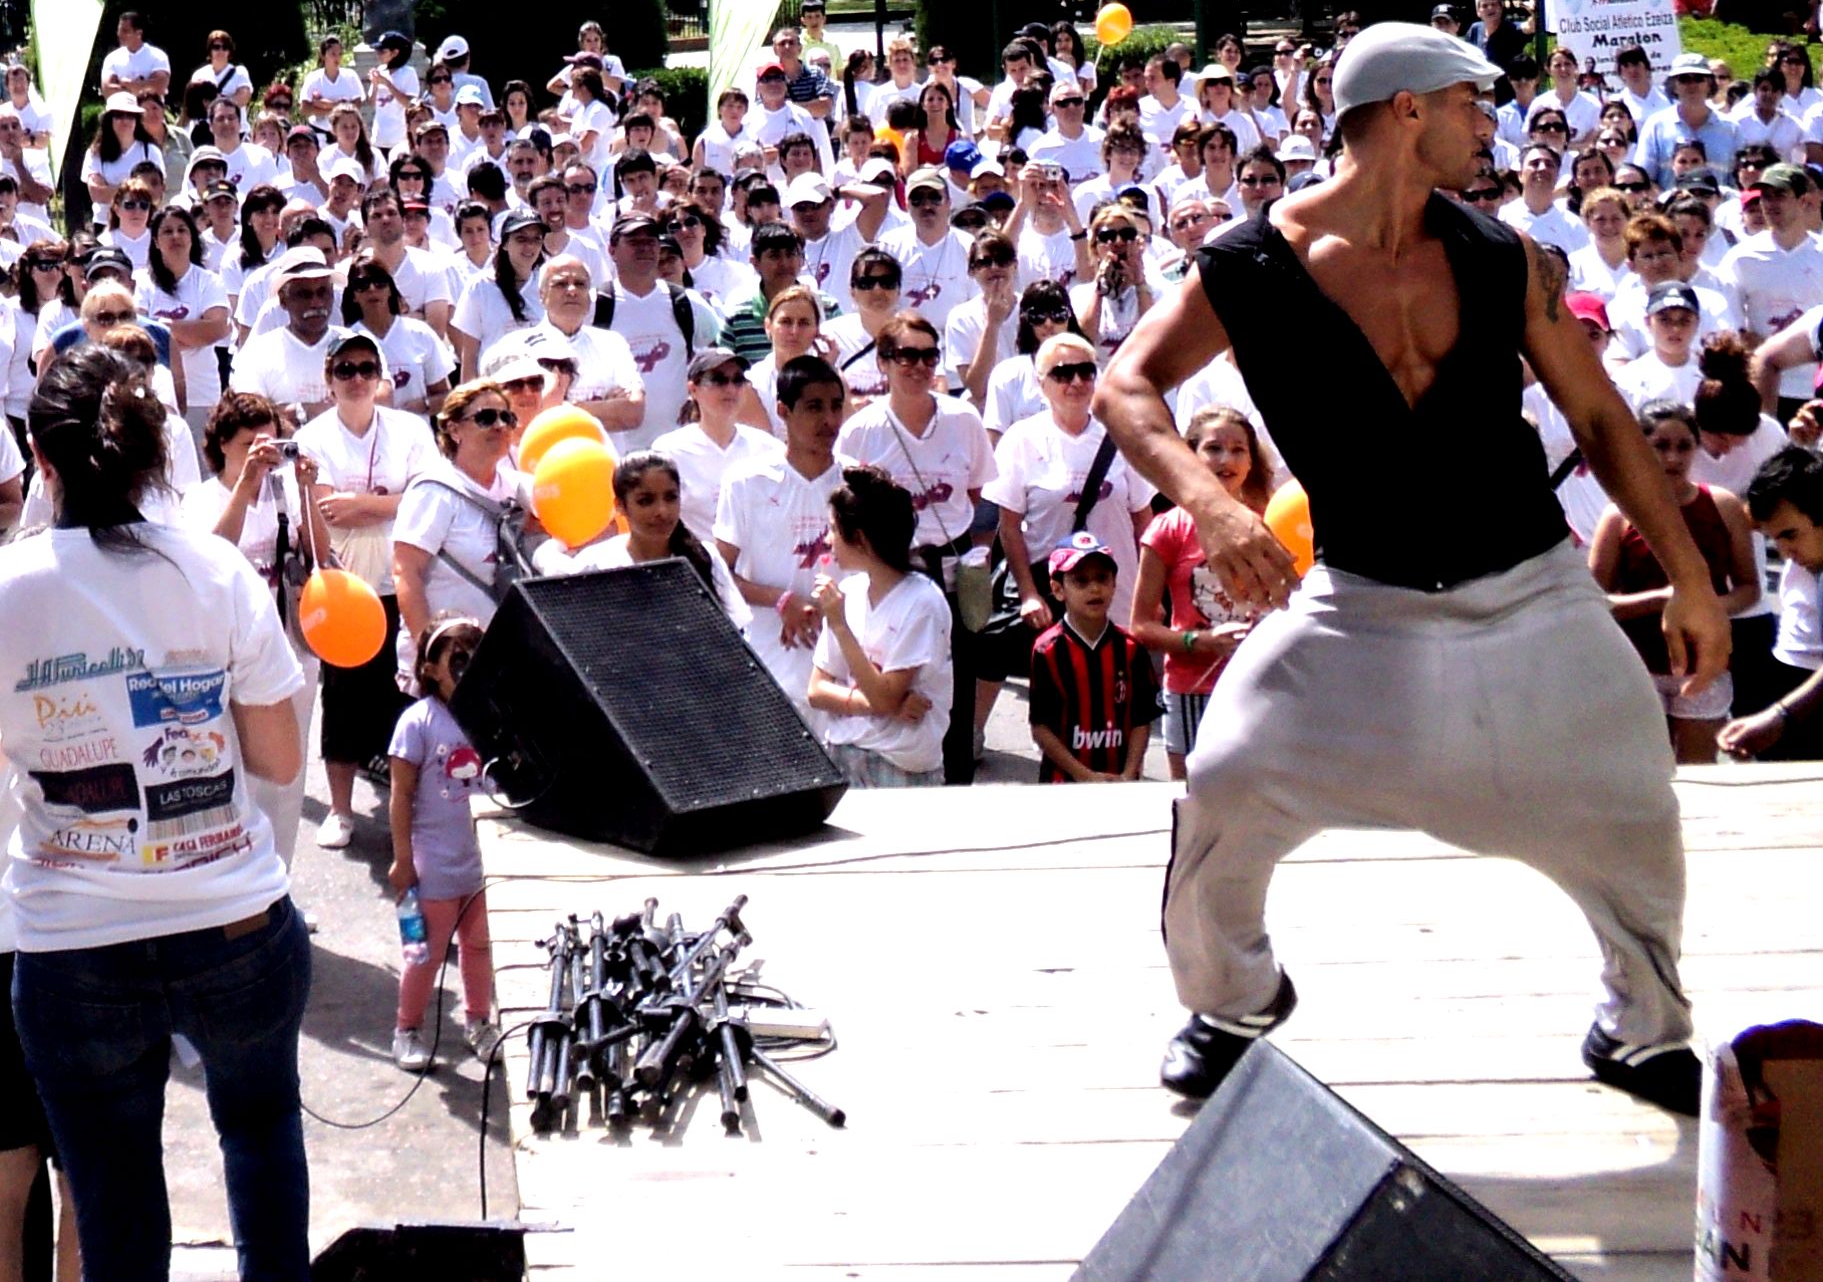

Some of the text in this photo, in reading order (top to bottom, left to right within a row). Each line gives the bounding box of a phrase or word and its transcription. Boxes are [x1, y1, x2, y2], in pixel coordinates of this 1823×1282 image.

[1559, 17, 1582, 34] Club
[1584, 16, 1611, 33] Social
[1645, 11, 1674, 27] Ezeiza
[1592, 31, 1663, 48] Maraton
[179, 674, 225, 693] Hogar
[1072, 720, 1123, 750] bwin
[39, 738, 118, 773] GUADALUPE
[50, 829, 136, 855] ARENA
